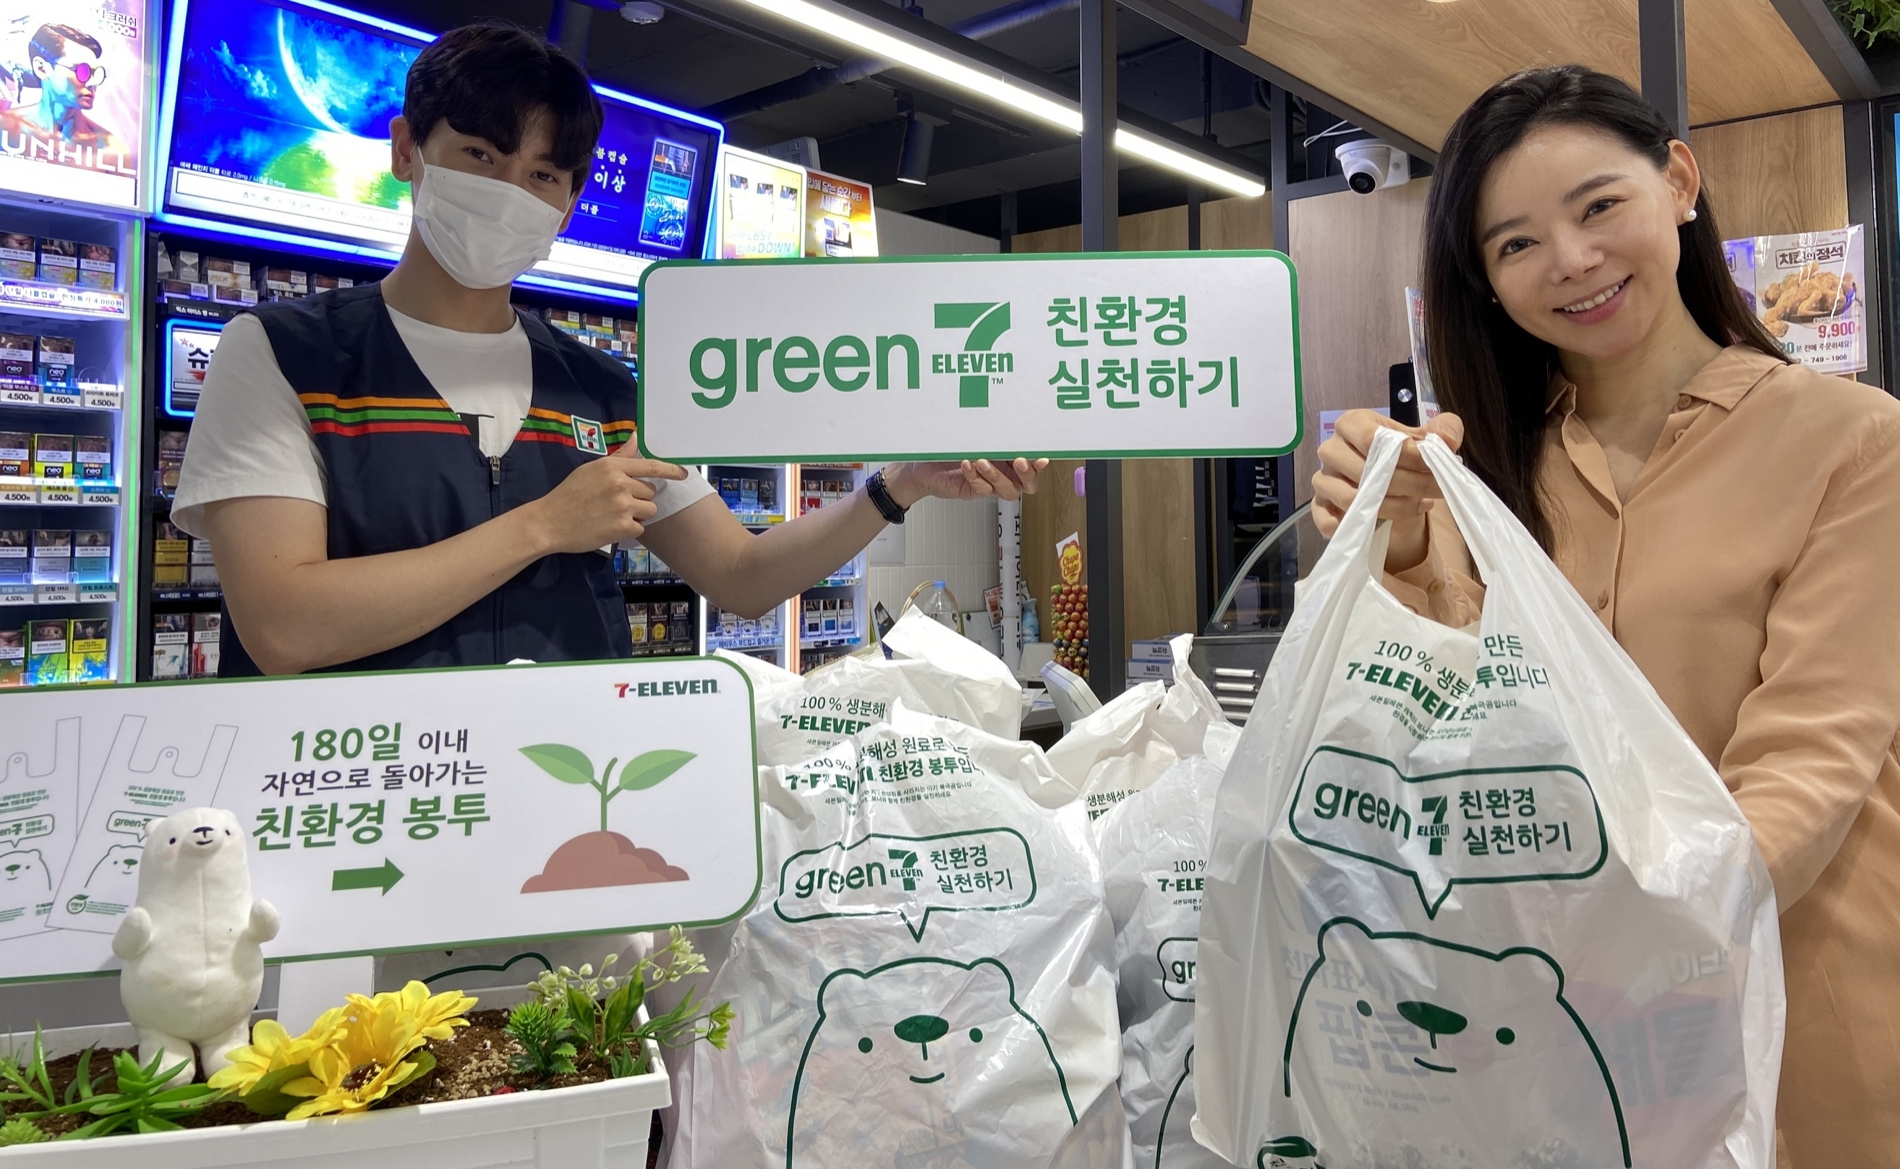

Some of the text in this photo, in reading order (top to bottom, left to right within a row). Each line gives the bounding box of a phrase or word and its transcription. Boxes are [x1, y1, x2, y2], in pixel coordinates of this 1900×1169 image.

[594, 166, 626, 193] 이상
[1047, 295, 1187, 347] 친환경
[690, 334, 920, 409] green
[1049, 356, 1239, 410] 실천하기
[1374, 640, 1413, 661] 100
[1484, 634, 1523, 658] 만든
[1476, 663, 1551, 690] 투입니다
[800, 696, 887, 719] 100 % 생분해
[292, 723, 468, 762] 180일 이내
[902, 737, 947, 754] 원료로
[261, 758, 488, 798] 자연으로 돌아가는
[879, 758, 923, 783] 친환경
[1313, 782, 1412, 840] green
[1459, 787, 1537, 820] 친환경
[253, 794, 490, 851] 친환경 봉투
[1462, 821, 1572, 856] 실천하기
[930, 844, 988, 871] 친환경
[1173, 860, 1196, 872] 100
[795, 862, 887, 898] green
[936, 868, 1014, 895] 실천하기
[1158, 877, 1205, 892] 7-ELE
[1171, 961, 1197, 984] gr
